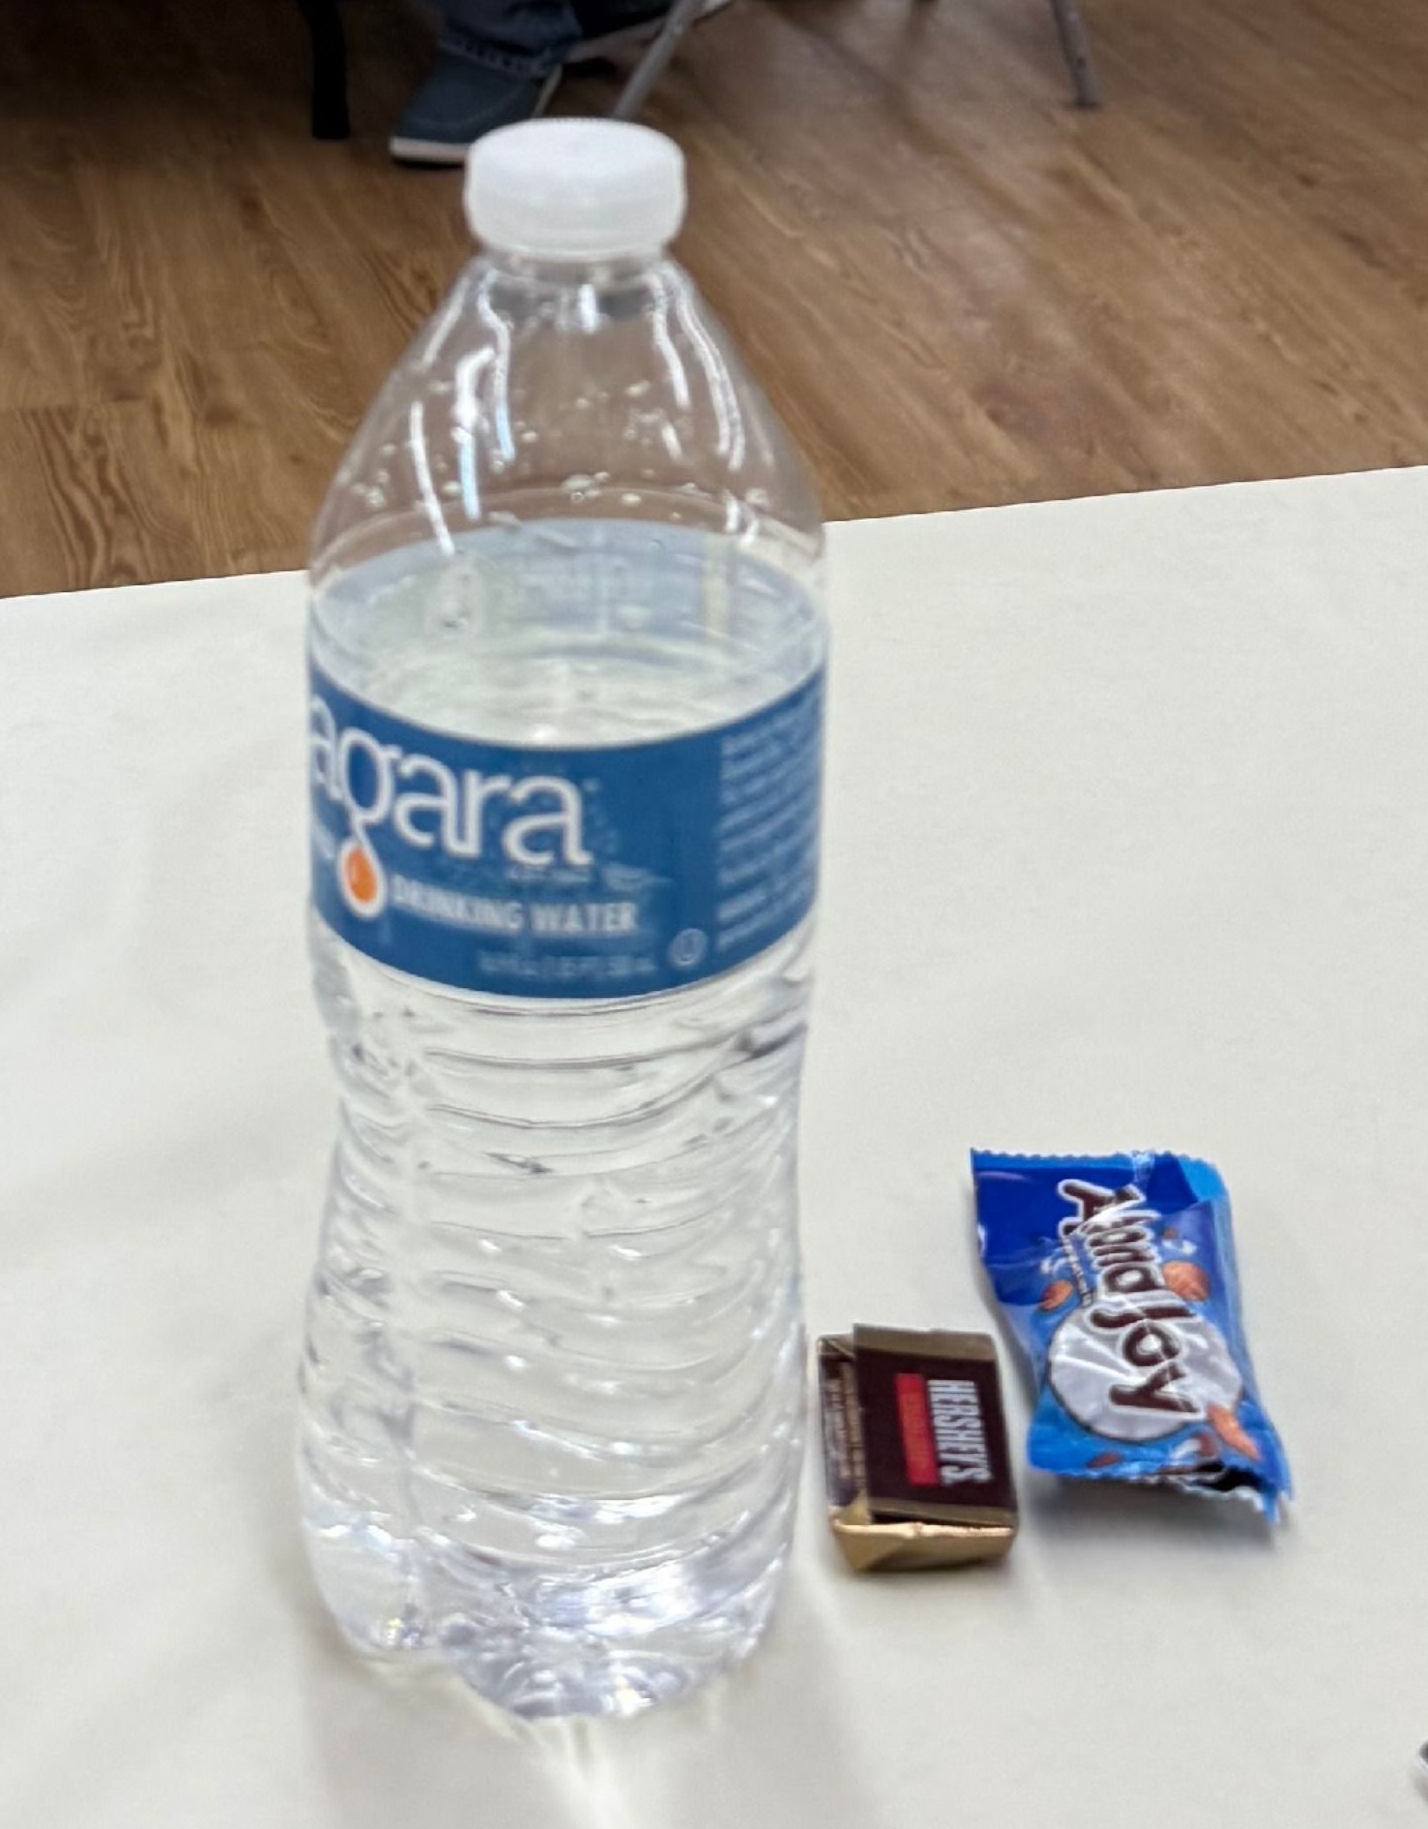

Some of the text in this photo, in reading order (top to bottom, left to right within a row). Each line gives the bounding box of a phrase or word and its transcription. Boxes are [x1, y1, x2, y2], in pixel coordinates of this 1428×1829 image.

[393, 875, 523, 932] DRINKING
[529, 899, 639, 934] WATER
[927, 1379, 992, 1486] HERSHEY'S
